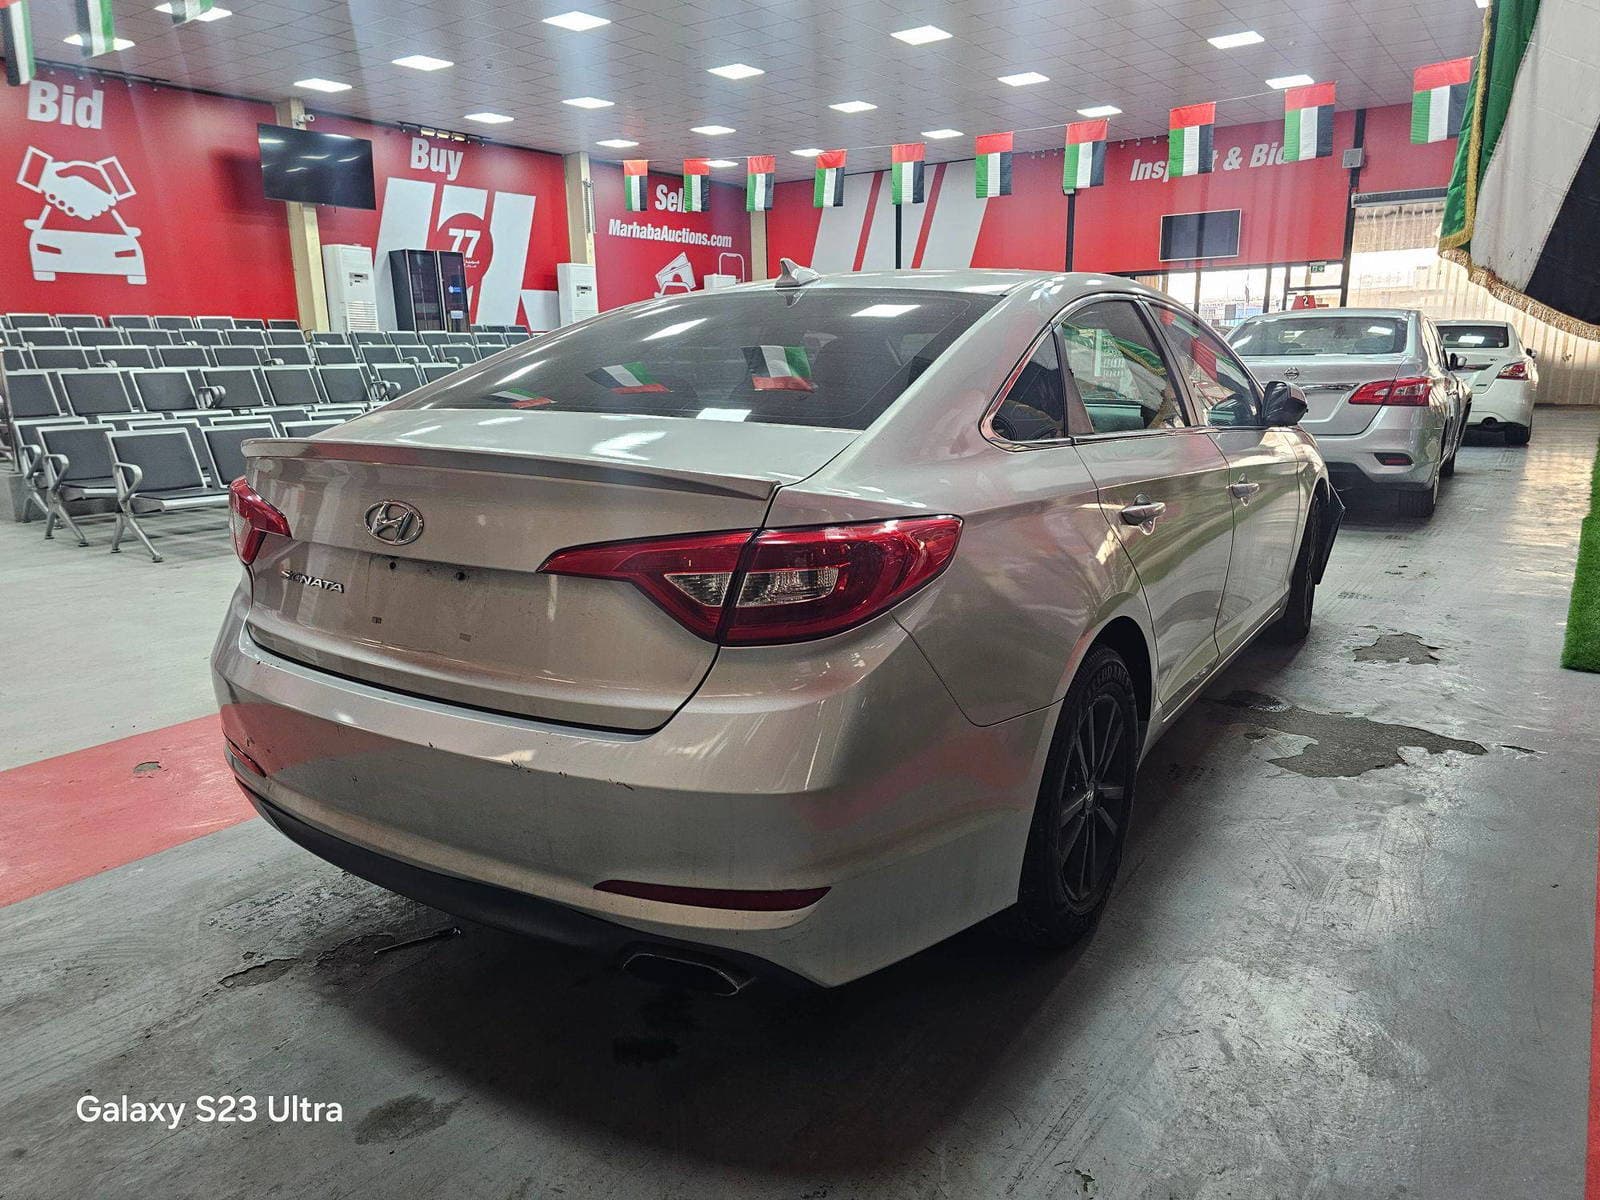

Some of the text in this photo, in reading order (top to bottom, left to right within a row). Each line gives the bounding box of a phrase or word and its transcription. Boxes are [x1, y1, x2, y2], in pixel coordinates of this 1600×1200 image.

[27, 80, 104, 130] Bid
[410, 137, 463, 181] Buy
[1223, 146, 1243, 171] &
[655, 184, 691, 213] Sel
[448, 228, 481, 258] 77
[608, 218, 732, 248] MarhabaAuctions.com
[280, 569, 345, 594] SONATA
